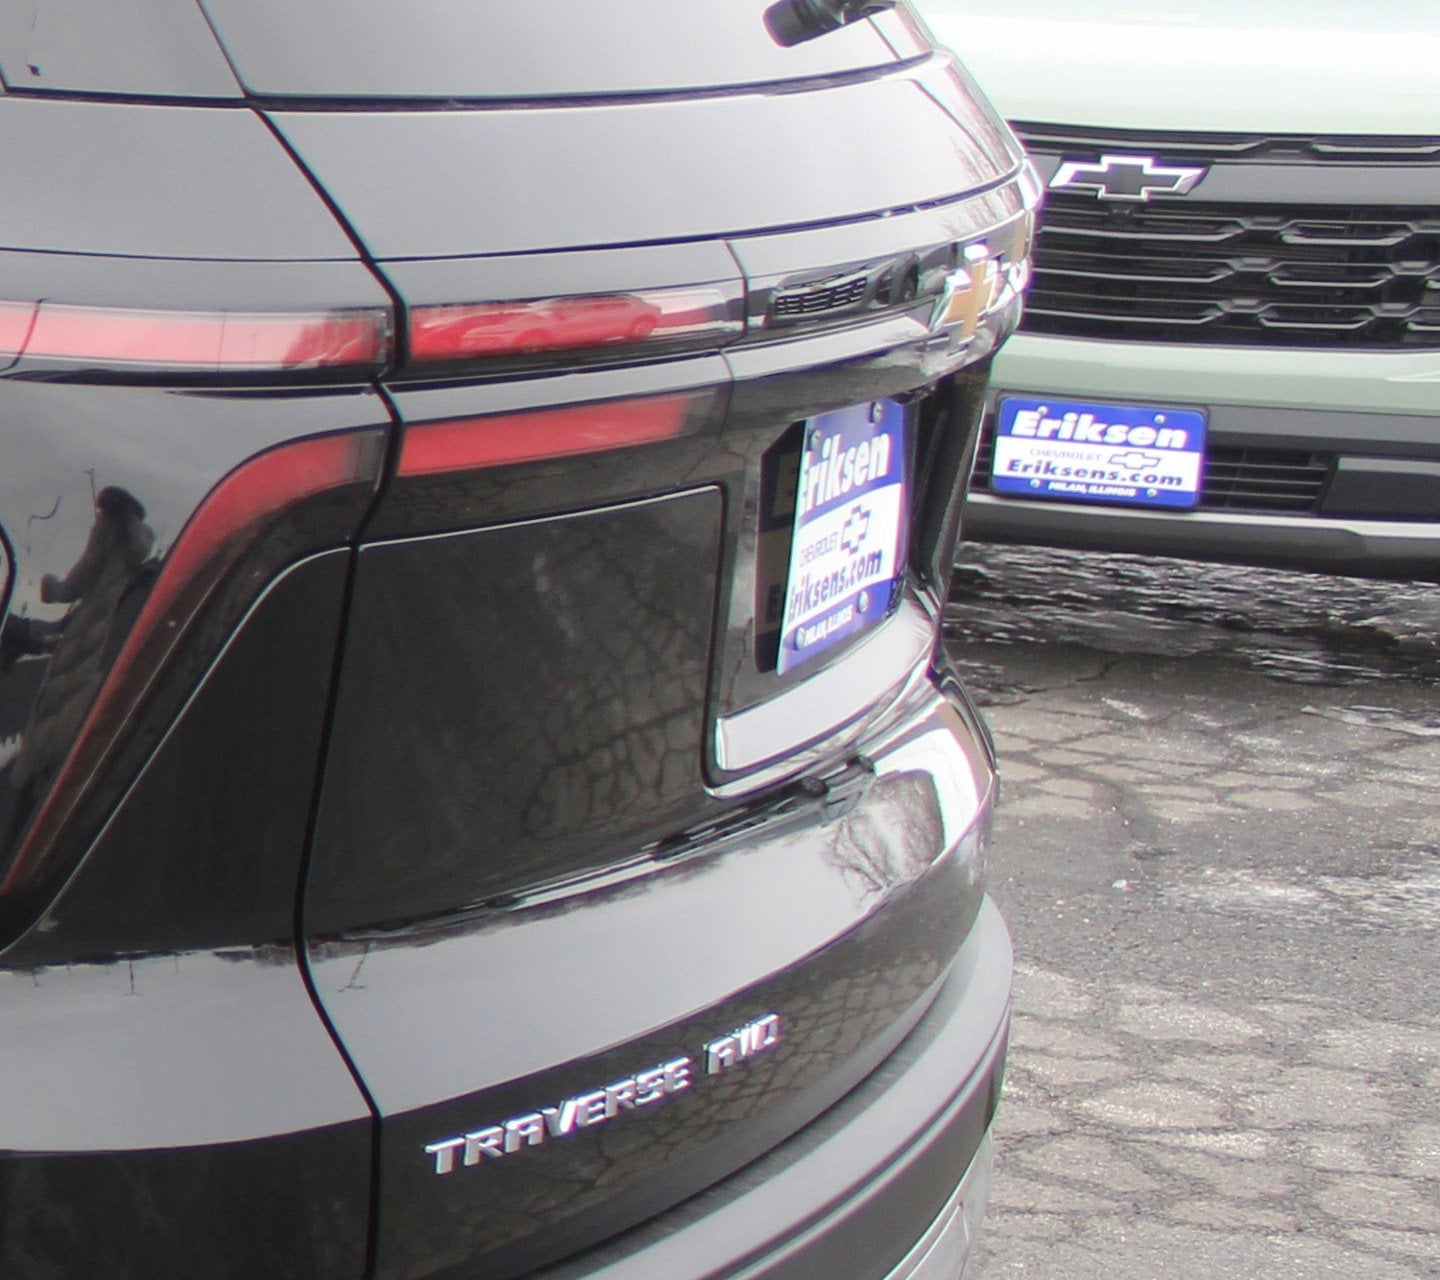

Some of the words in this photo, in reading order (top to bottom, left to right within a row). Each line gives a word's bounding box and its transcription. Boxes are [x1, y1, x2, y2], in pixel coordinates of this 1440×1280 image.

[1011, 410, 1187, 449] Eriksen
[1030, 448, 1102, 462] CHEVROLET
[1008, 458, 1183, 486] Eriksens.com
[423, 1056, 692, 1174] TRAVERSE
[703, 1013, 781, 1075] AWD
